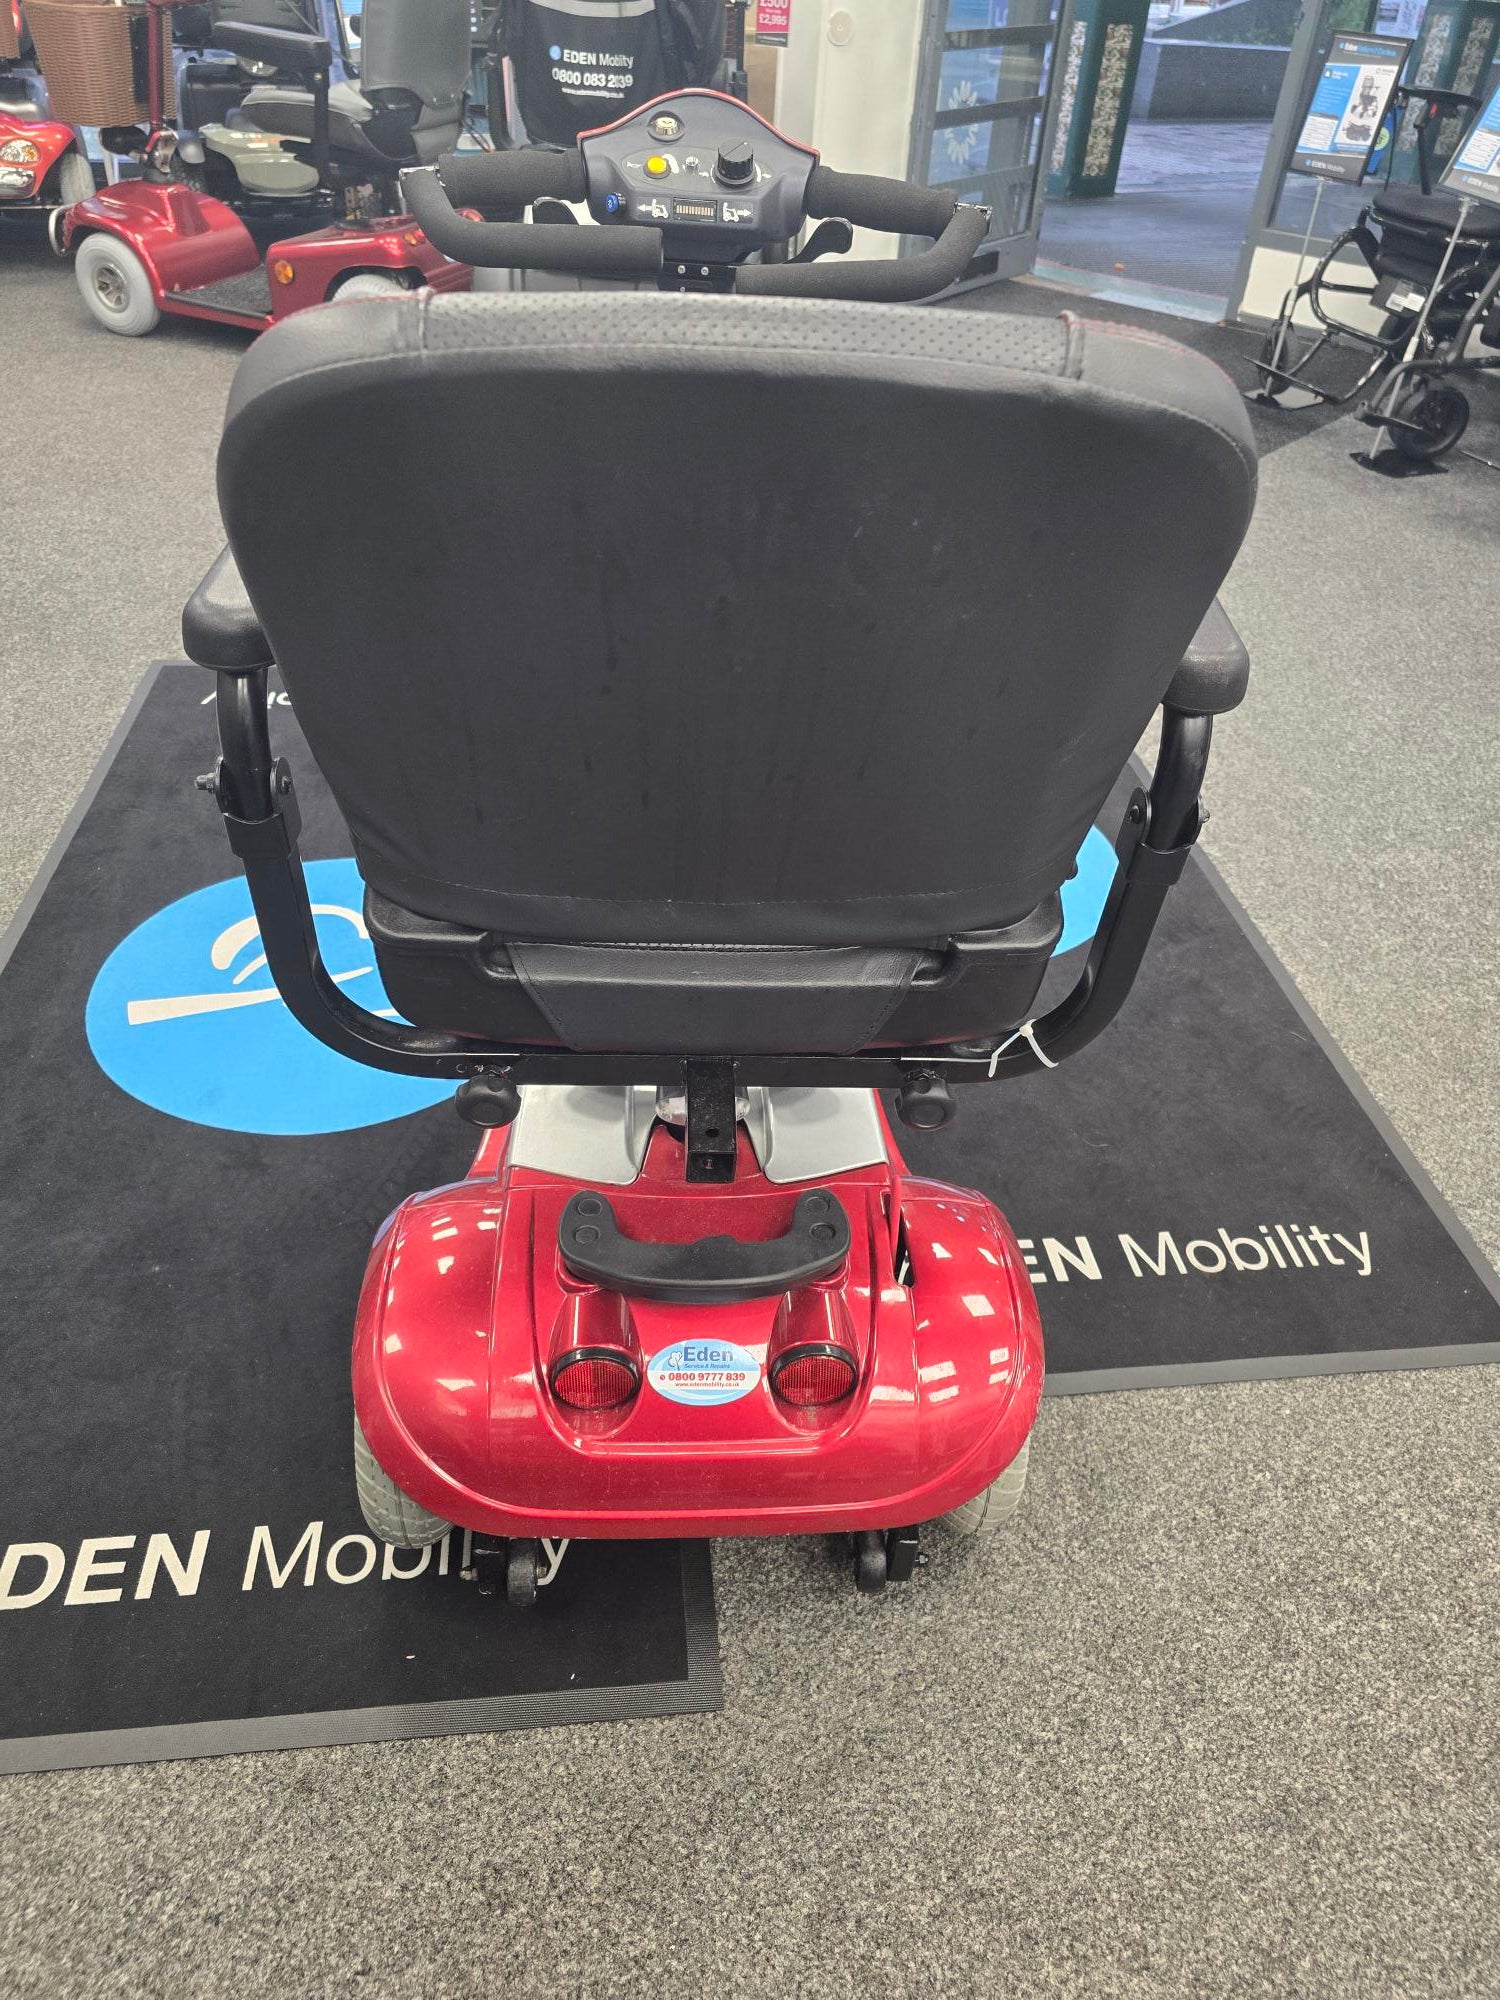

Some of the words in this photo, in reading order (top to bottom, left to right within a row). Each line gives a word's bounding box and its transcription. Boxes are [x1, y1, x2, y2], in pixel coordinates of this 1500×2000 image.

[563, 49, 597, 66] EDEN
[552, 67, 581, 86] 0800
[583, 72, 606, 88] 083
[1118, 1224, 1372, 1277] Mobility
[683, 1346, 734, 1362] Eden
[668, 1373, 696, 1381] 0800
[698, 1373, 723, 1381] 9777
[725, 1373, 746, 1381] 839
[241, 1520, 570, 1592] Mobily
